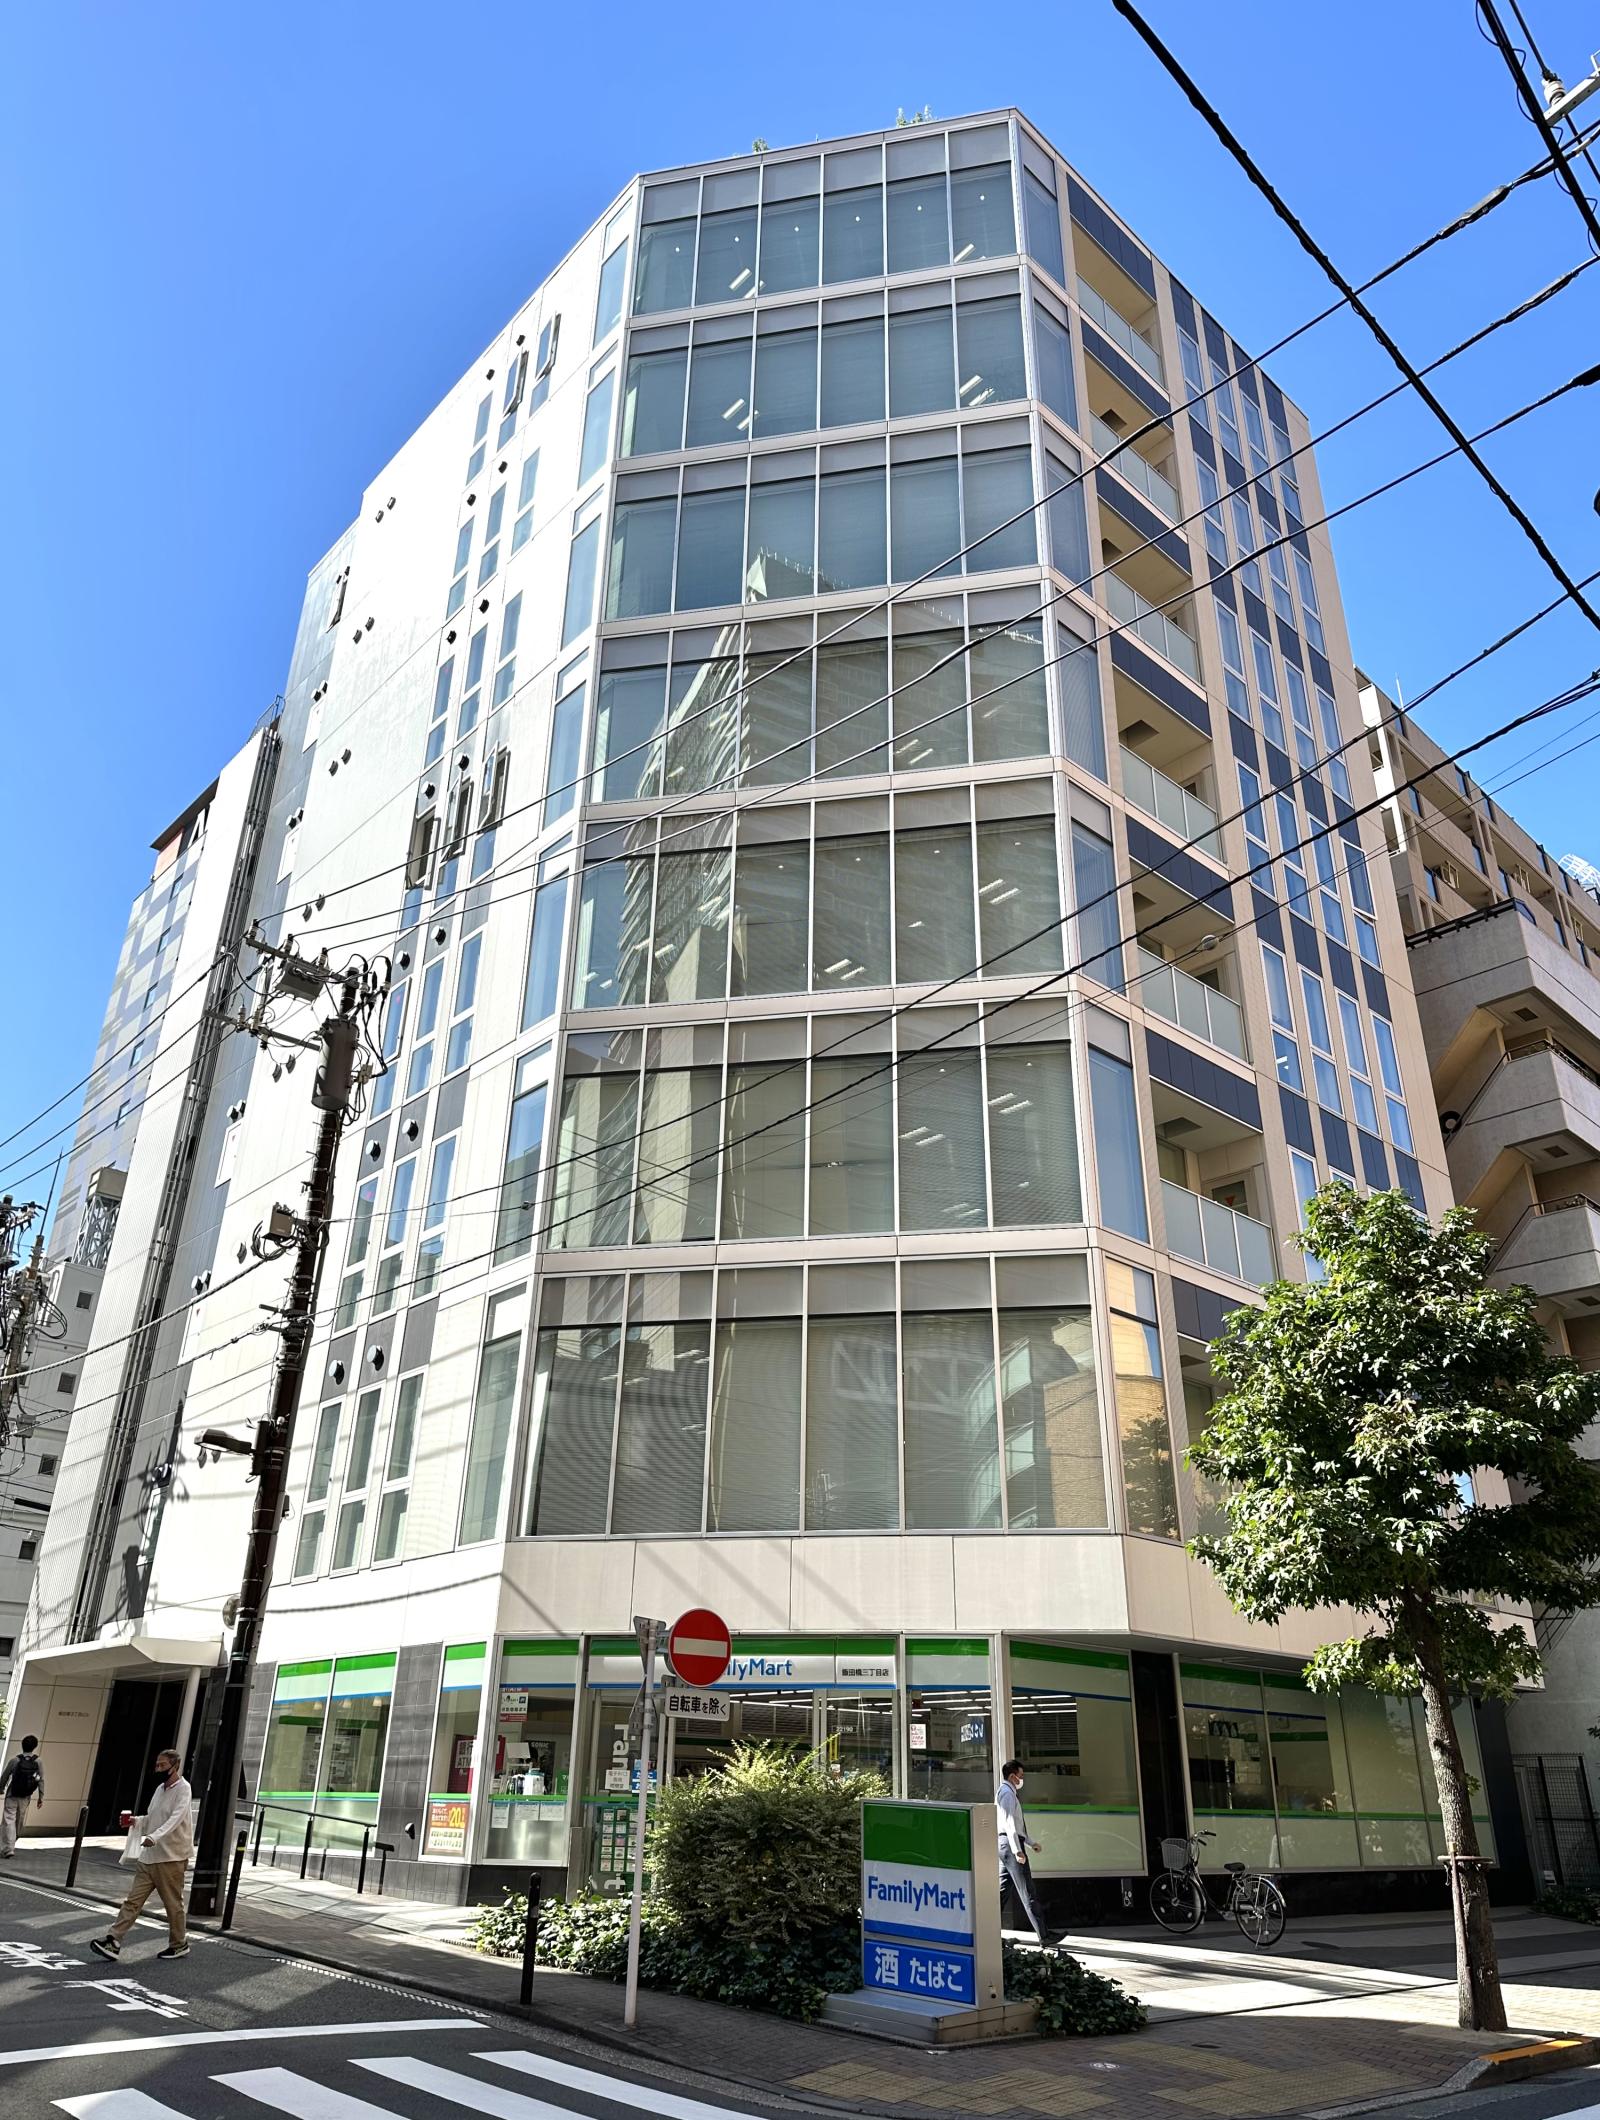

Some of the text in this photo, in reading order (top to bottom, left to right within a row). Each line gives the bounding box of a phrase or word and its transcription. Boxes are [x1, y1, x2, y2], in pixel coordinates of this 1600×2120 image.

[725, 1658, 793, 1680] ilyMart
[669, 1694, 727, 1716] 自転車を除く
[867, 1875, 966, 1912] FamilyMart
[874, 1946, 963, 1992] 酒 たばこ
